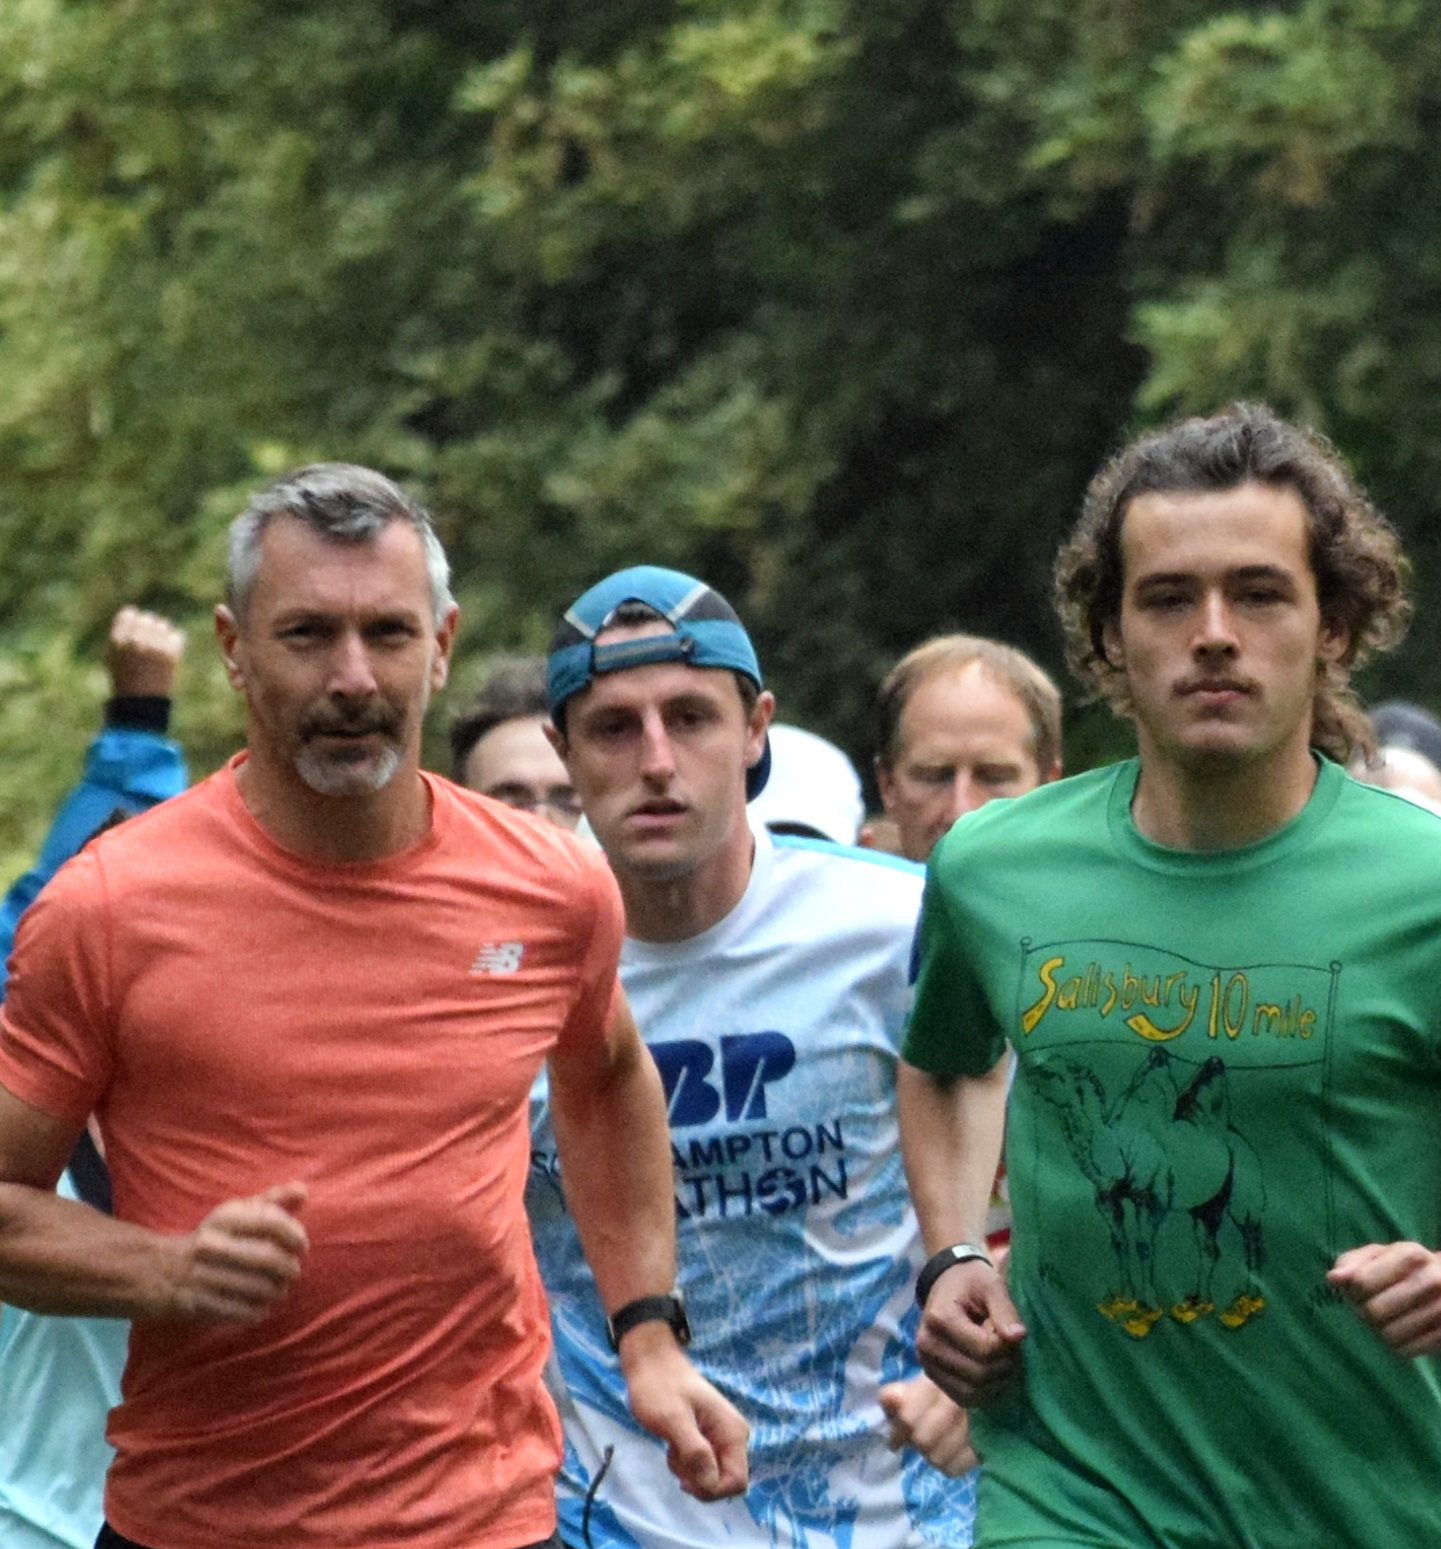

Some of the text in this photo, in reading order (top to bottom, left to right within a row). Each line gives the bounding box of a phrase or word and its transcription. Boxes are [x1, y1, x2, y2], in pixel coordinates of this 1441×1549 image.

[1020, 956, 1317, 1042] Salisbury 10 mile
